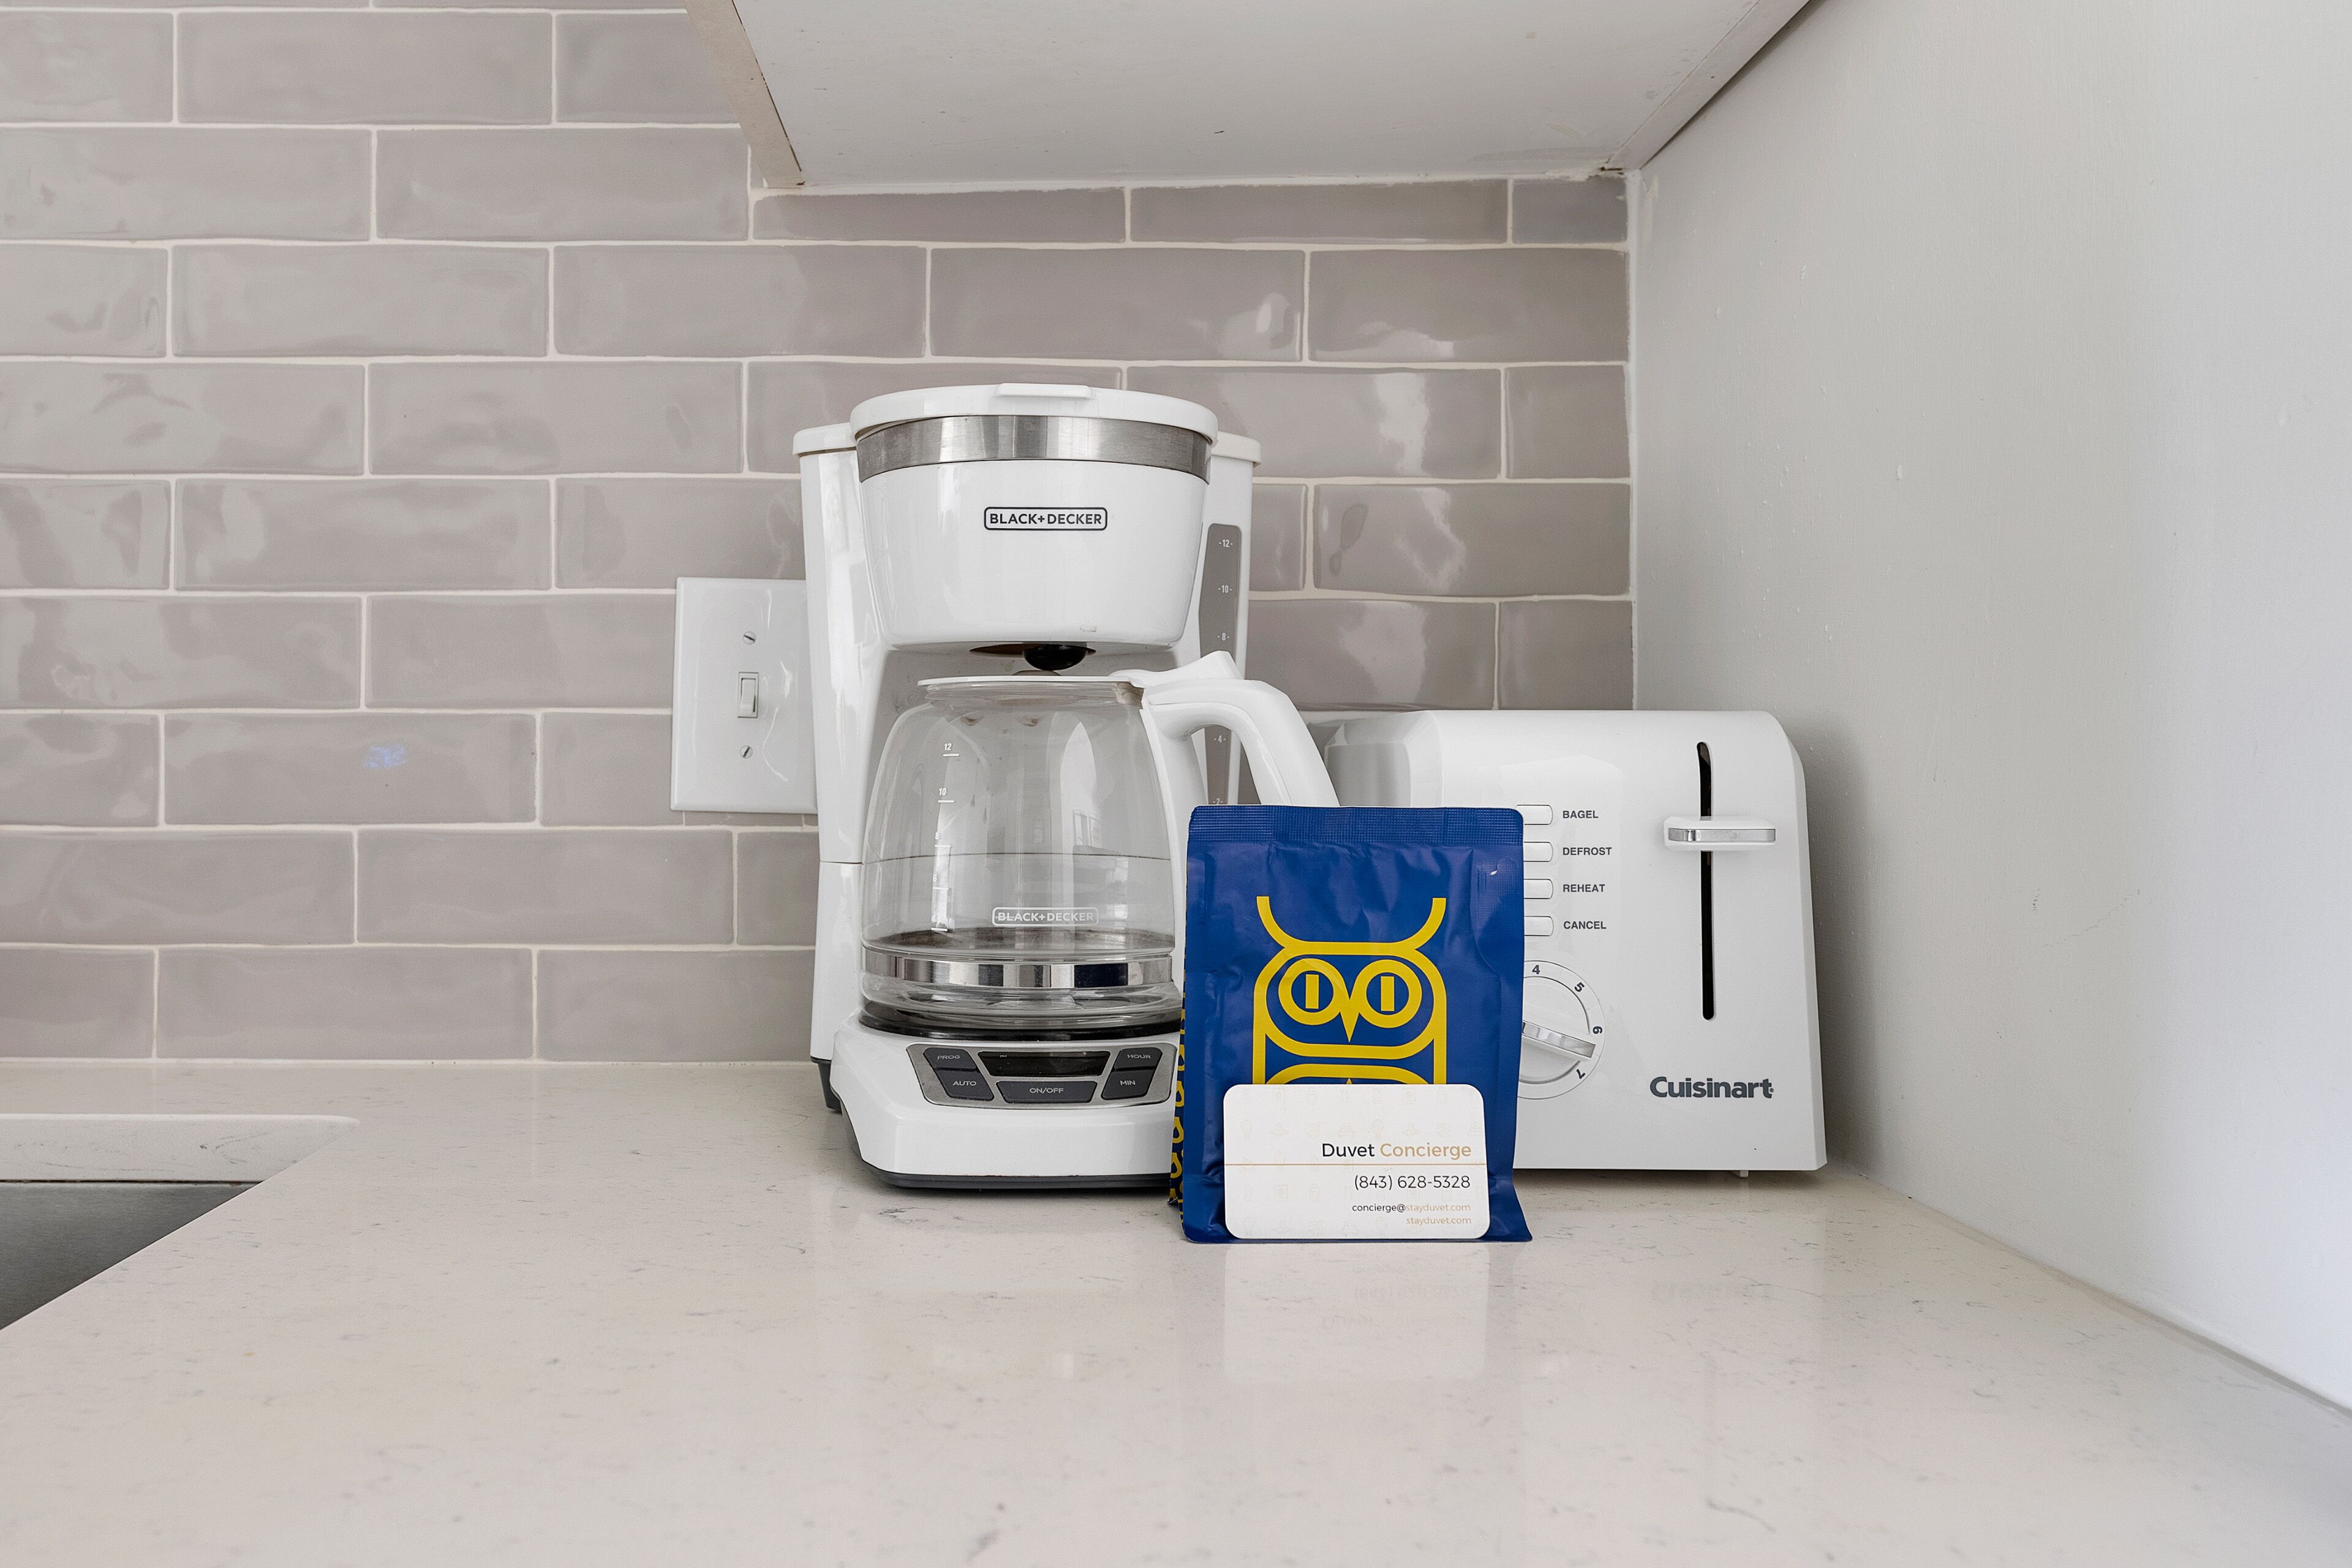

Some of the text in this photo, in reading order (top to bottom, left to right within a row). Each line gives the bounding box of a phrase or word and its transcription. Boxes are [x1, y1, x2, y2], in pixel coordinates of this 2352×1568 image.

[989, 513, 1102, 525] BLACK+DECKER
[1562, 847, 1612, 856] DEFROST
[997, 912, 1093, 921] BLACK+DECKER
[1532, 965, 1540, 974] 4
[1574, 982, 1585, 992] 5
[1576, 1069, 1586, 1079] 7
[1650, 1076, 1772, 1098] Cuisinart
[1322, 1142, 1471, 1160] Duvet Concierge
[1354, 1175, 1471, 1190] (843) 628-5328
[1352, 1204, 1471, 1213] concierge@stayduvet.com
[1406, 1216, 1472, 1226] stayduvet.com
